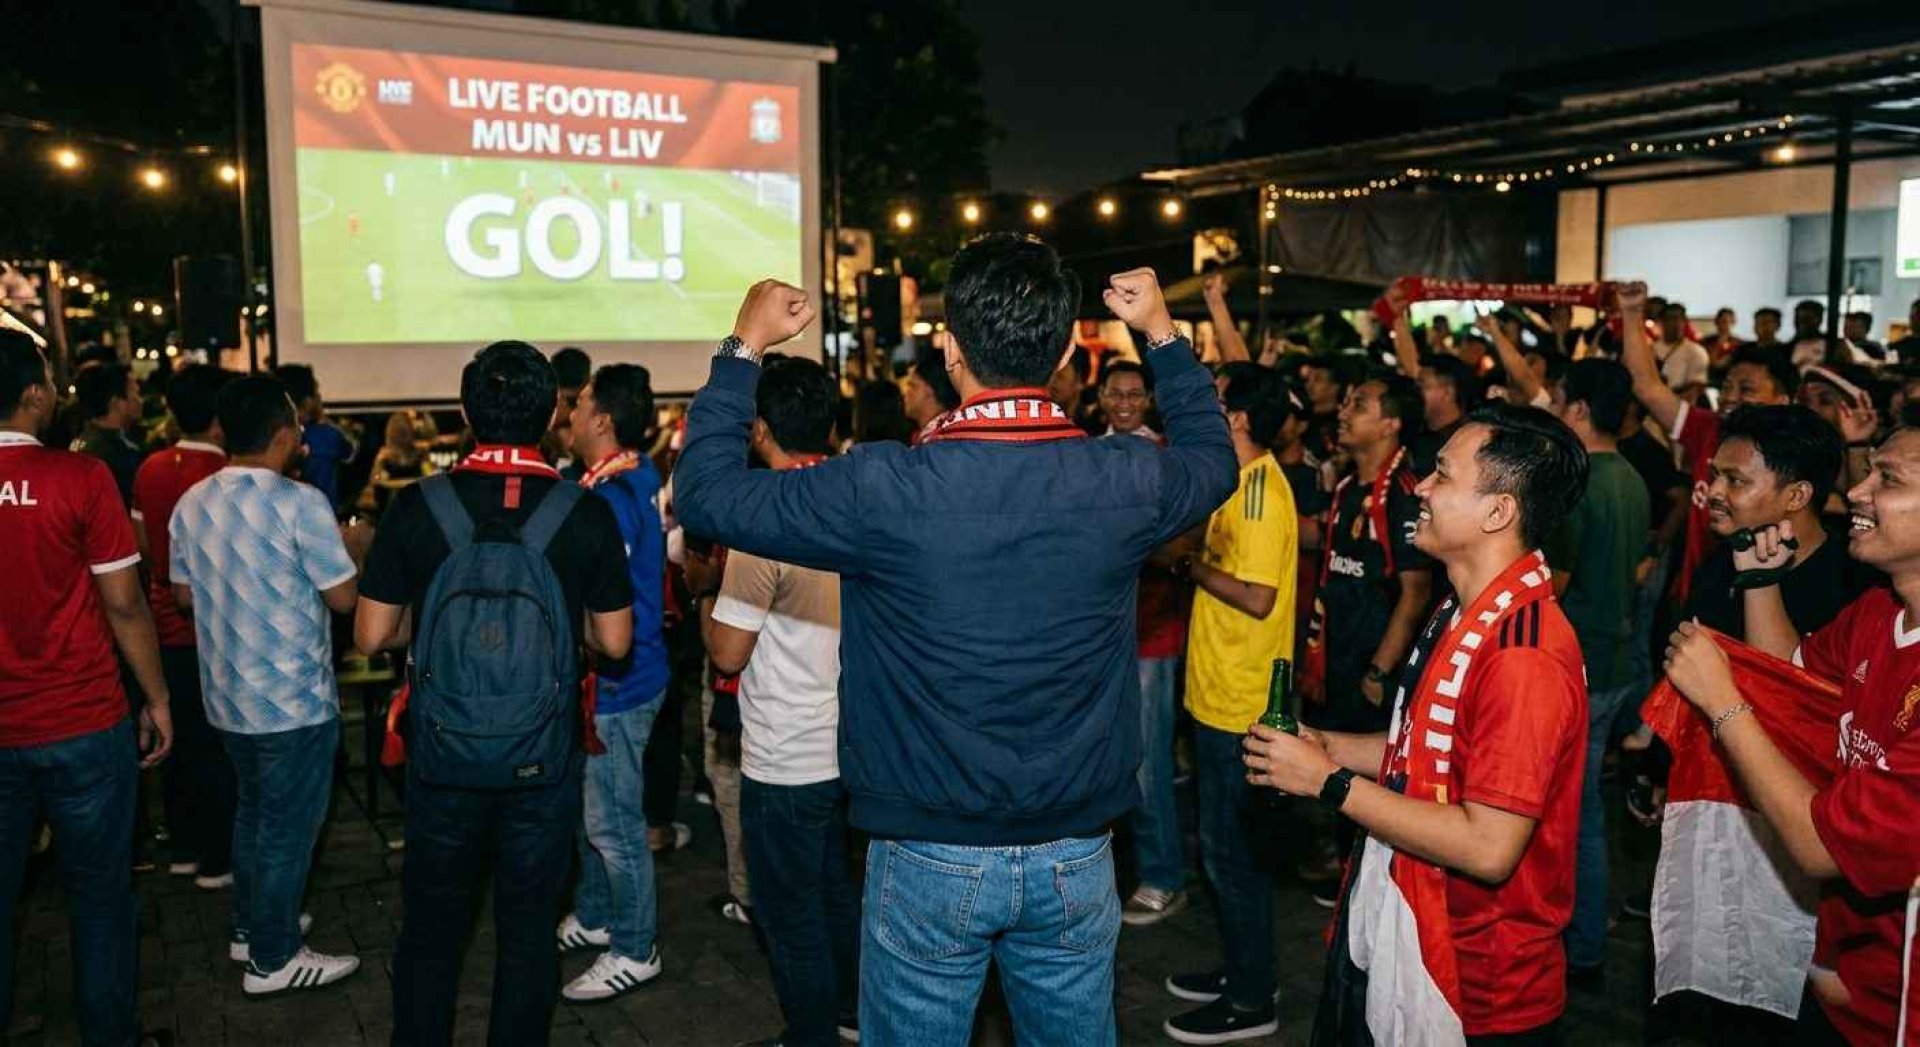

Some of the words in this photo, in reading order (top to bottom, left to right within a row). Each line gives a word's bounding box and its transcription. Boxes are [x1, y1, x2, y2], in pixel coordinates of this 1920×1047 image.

[448, 77, 522, 112] LIVE
[527, 82, 687, 124] FOOTBALL
[471, 118, 561, 154] MUN
[567, 132, 602, 156] vs
[609, 127, 665, 158] LIV
[444, 191, 686, 282] GOL!
[0, 479, 38, 506] AL
